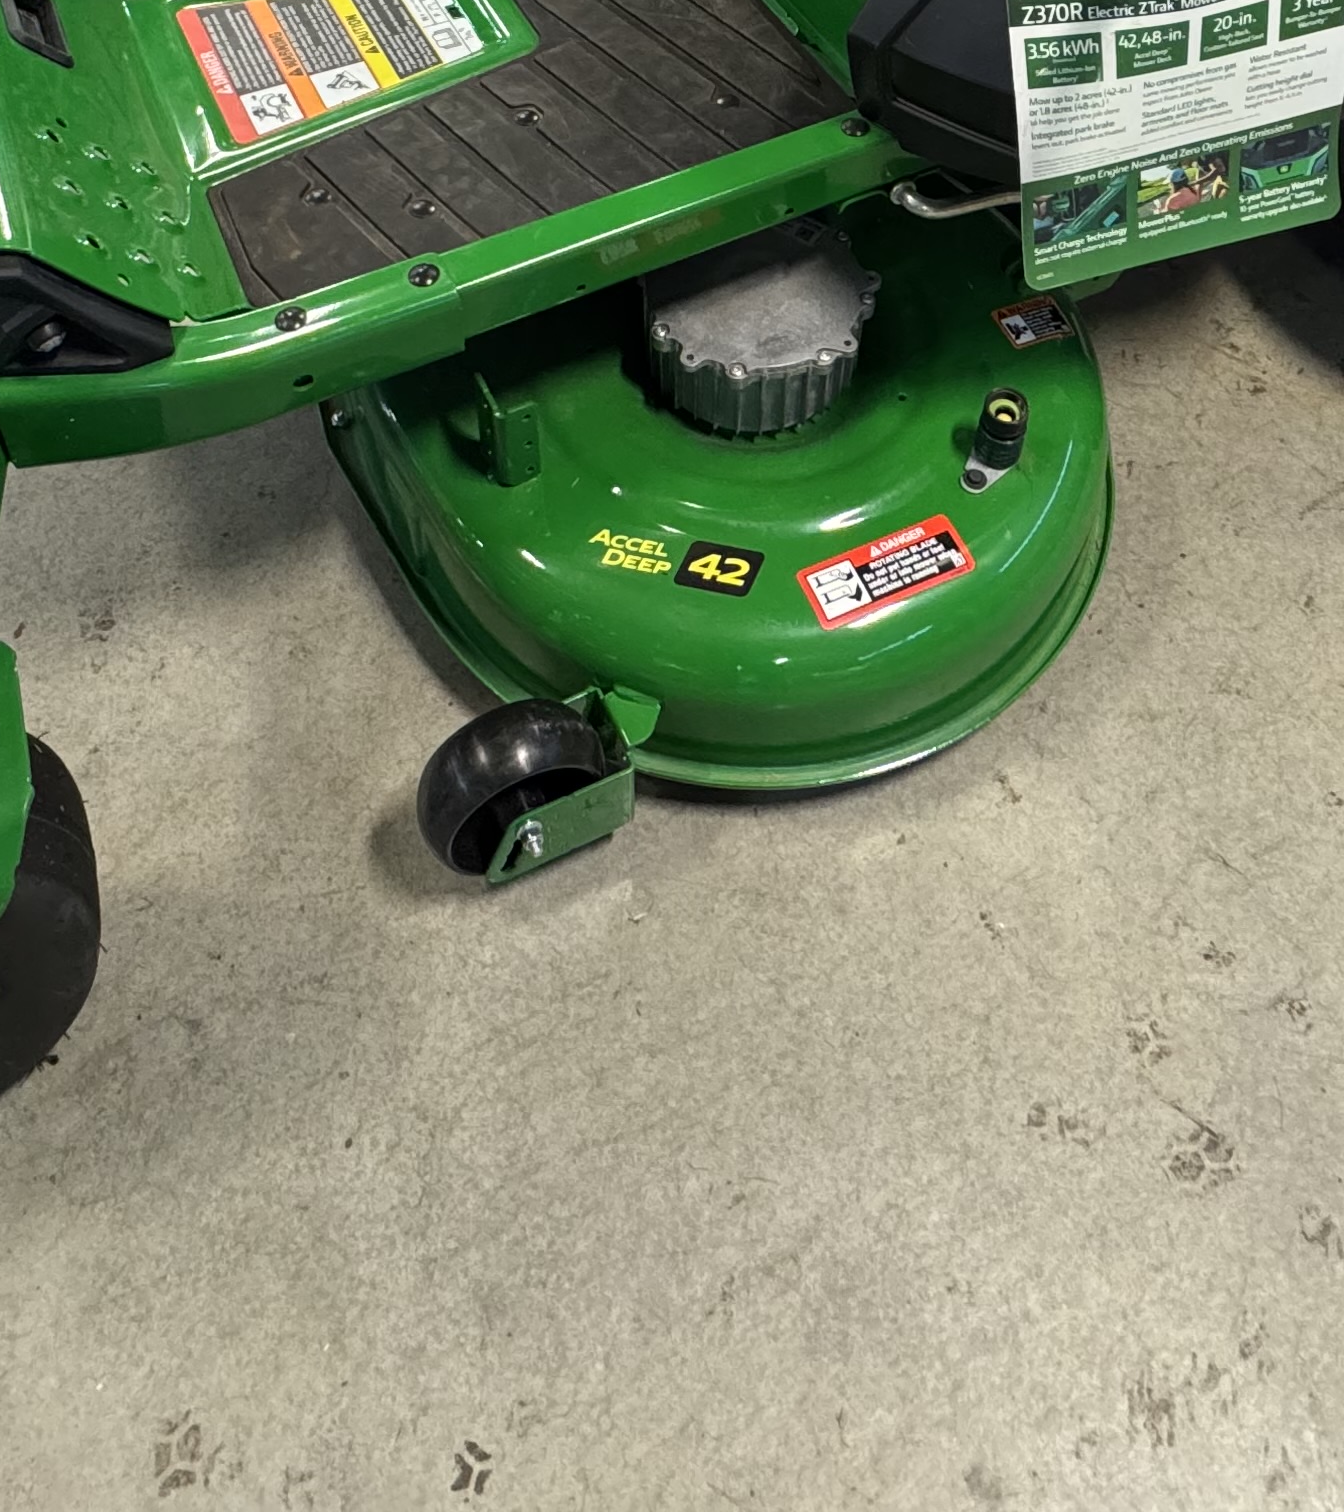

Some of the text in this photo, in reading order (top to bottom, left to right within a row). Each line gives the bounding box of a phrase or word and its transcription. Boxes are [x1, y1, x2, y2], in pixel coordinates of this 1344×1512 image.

[1021, 2, 1084, 25] Z370R
[1088, 6, 1135, 19] Electric
[1212, 11, 1257, 33] 20-in.
[346, 13, 374, 44] CAUTION
[1118, 28, 1186, 49] 42,48-in.
[268, 31, 298, 71] WARNING
[1062, 38, 1099, 57] kWh
[200, 50, 227, 85] DANGER
[1143, 81, 1155, 89] No
[1029, 97, 1050, 106] Mow
[1052, 96, 1063, 106] up
[1075, 93, 1080, 101] 2
[1081, 91, 1102, 100] acres
[1177, 101, 1192, 110] LED
[1031, 121, 1115, 141] Integrated park brake
[1055, 117, 1067, 125] you
[1068, 115, 1079, 123] get
[1073, 122, 1294, 185] Zero Engine Noise And Zero Operating Emissions
[1263, 187, 1290, 199] Battery
[1034, 227, 1127, 256] Smart Charge Technology
[588, 529, 668, 558] ACCEL
[879, 526, 926, 552] DANGER
[869, 537, 938, 570] ROTATING BLADE
[601, 548, 751, 587] DEEP 42
[863, 573, 875, 582] Do
[877, 566, 887, 576] not
[888, 563, 899, 575] put
[900, 553, 922, 567] hands
[922, 550, 930, 558] or
